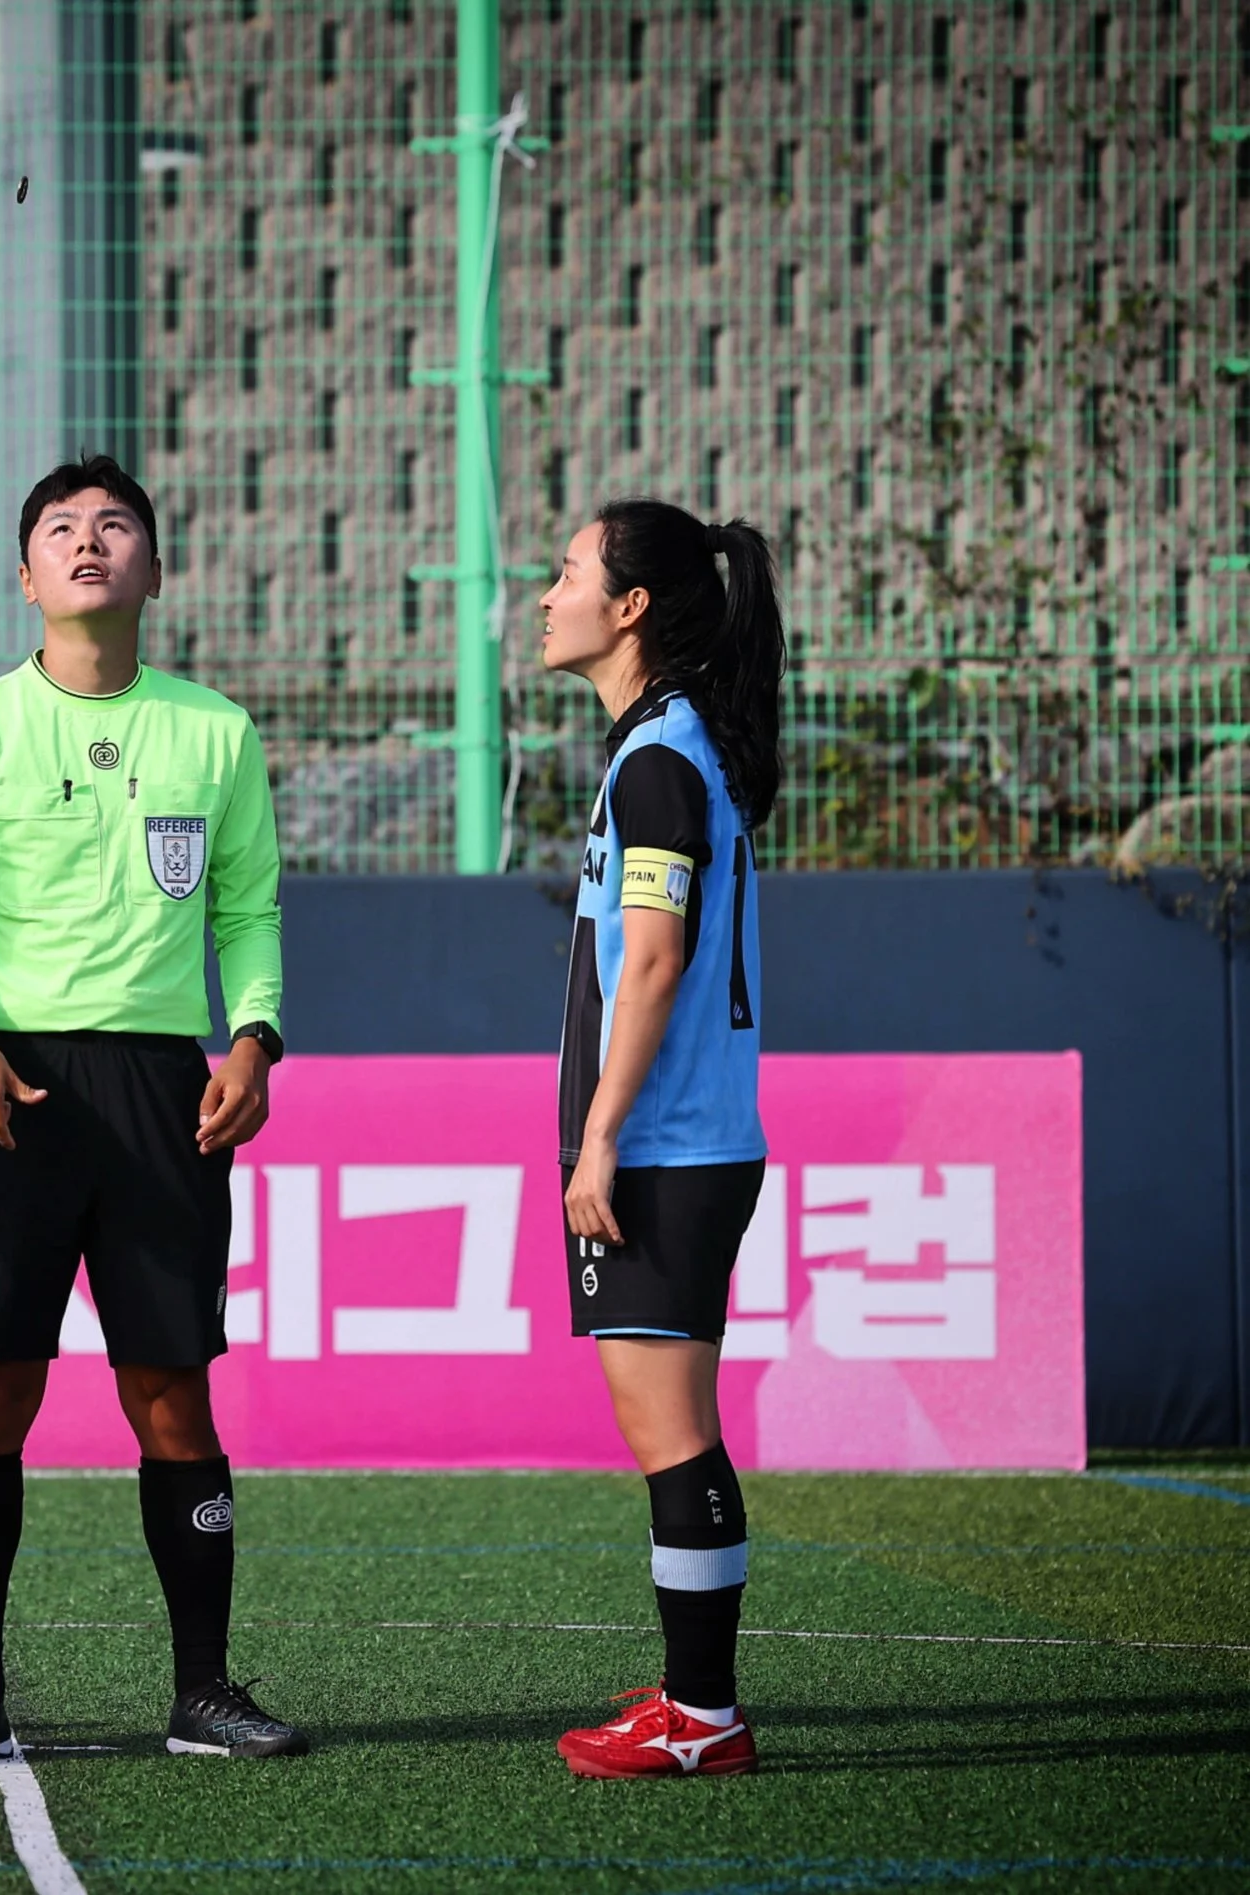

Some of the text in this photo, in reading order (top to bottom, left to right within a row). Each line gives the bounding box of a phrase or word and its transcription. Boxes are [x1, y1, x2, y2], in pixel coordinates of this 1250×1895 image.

[148, 820, 204, 834] REFEREE
[624, 871, 656, 884] PTAIN
[171, 886, 186, 895] KFA
